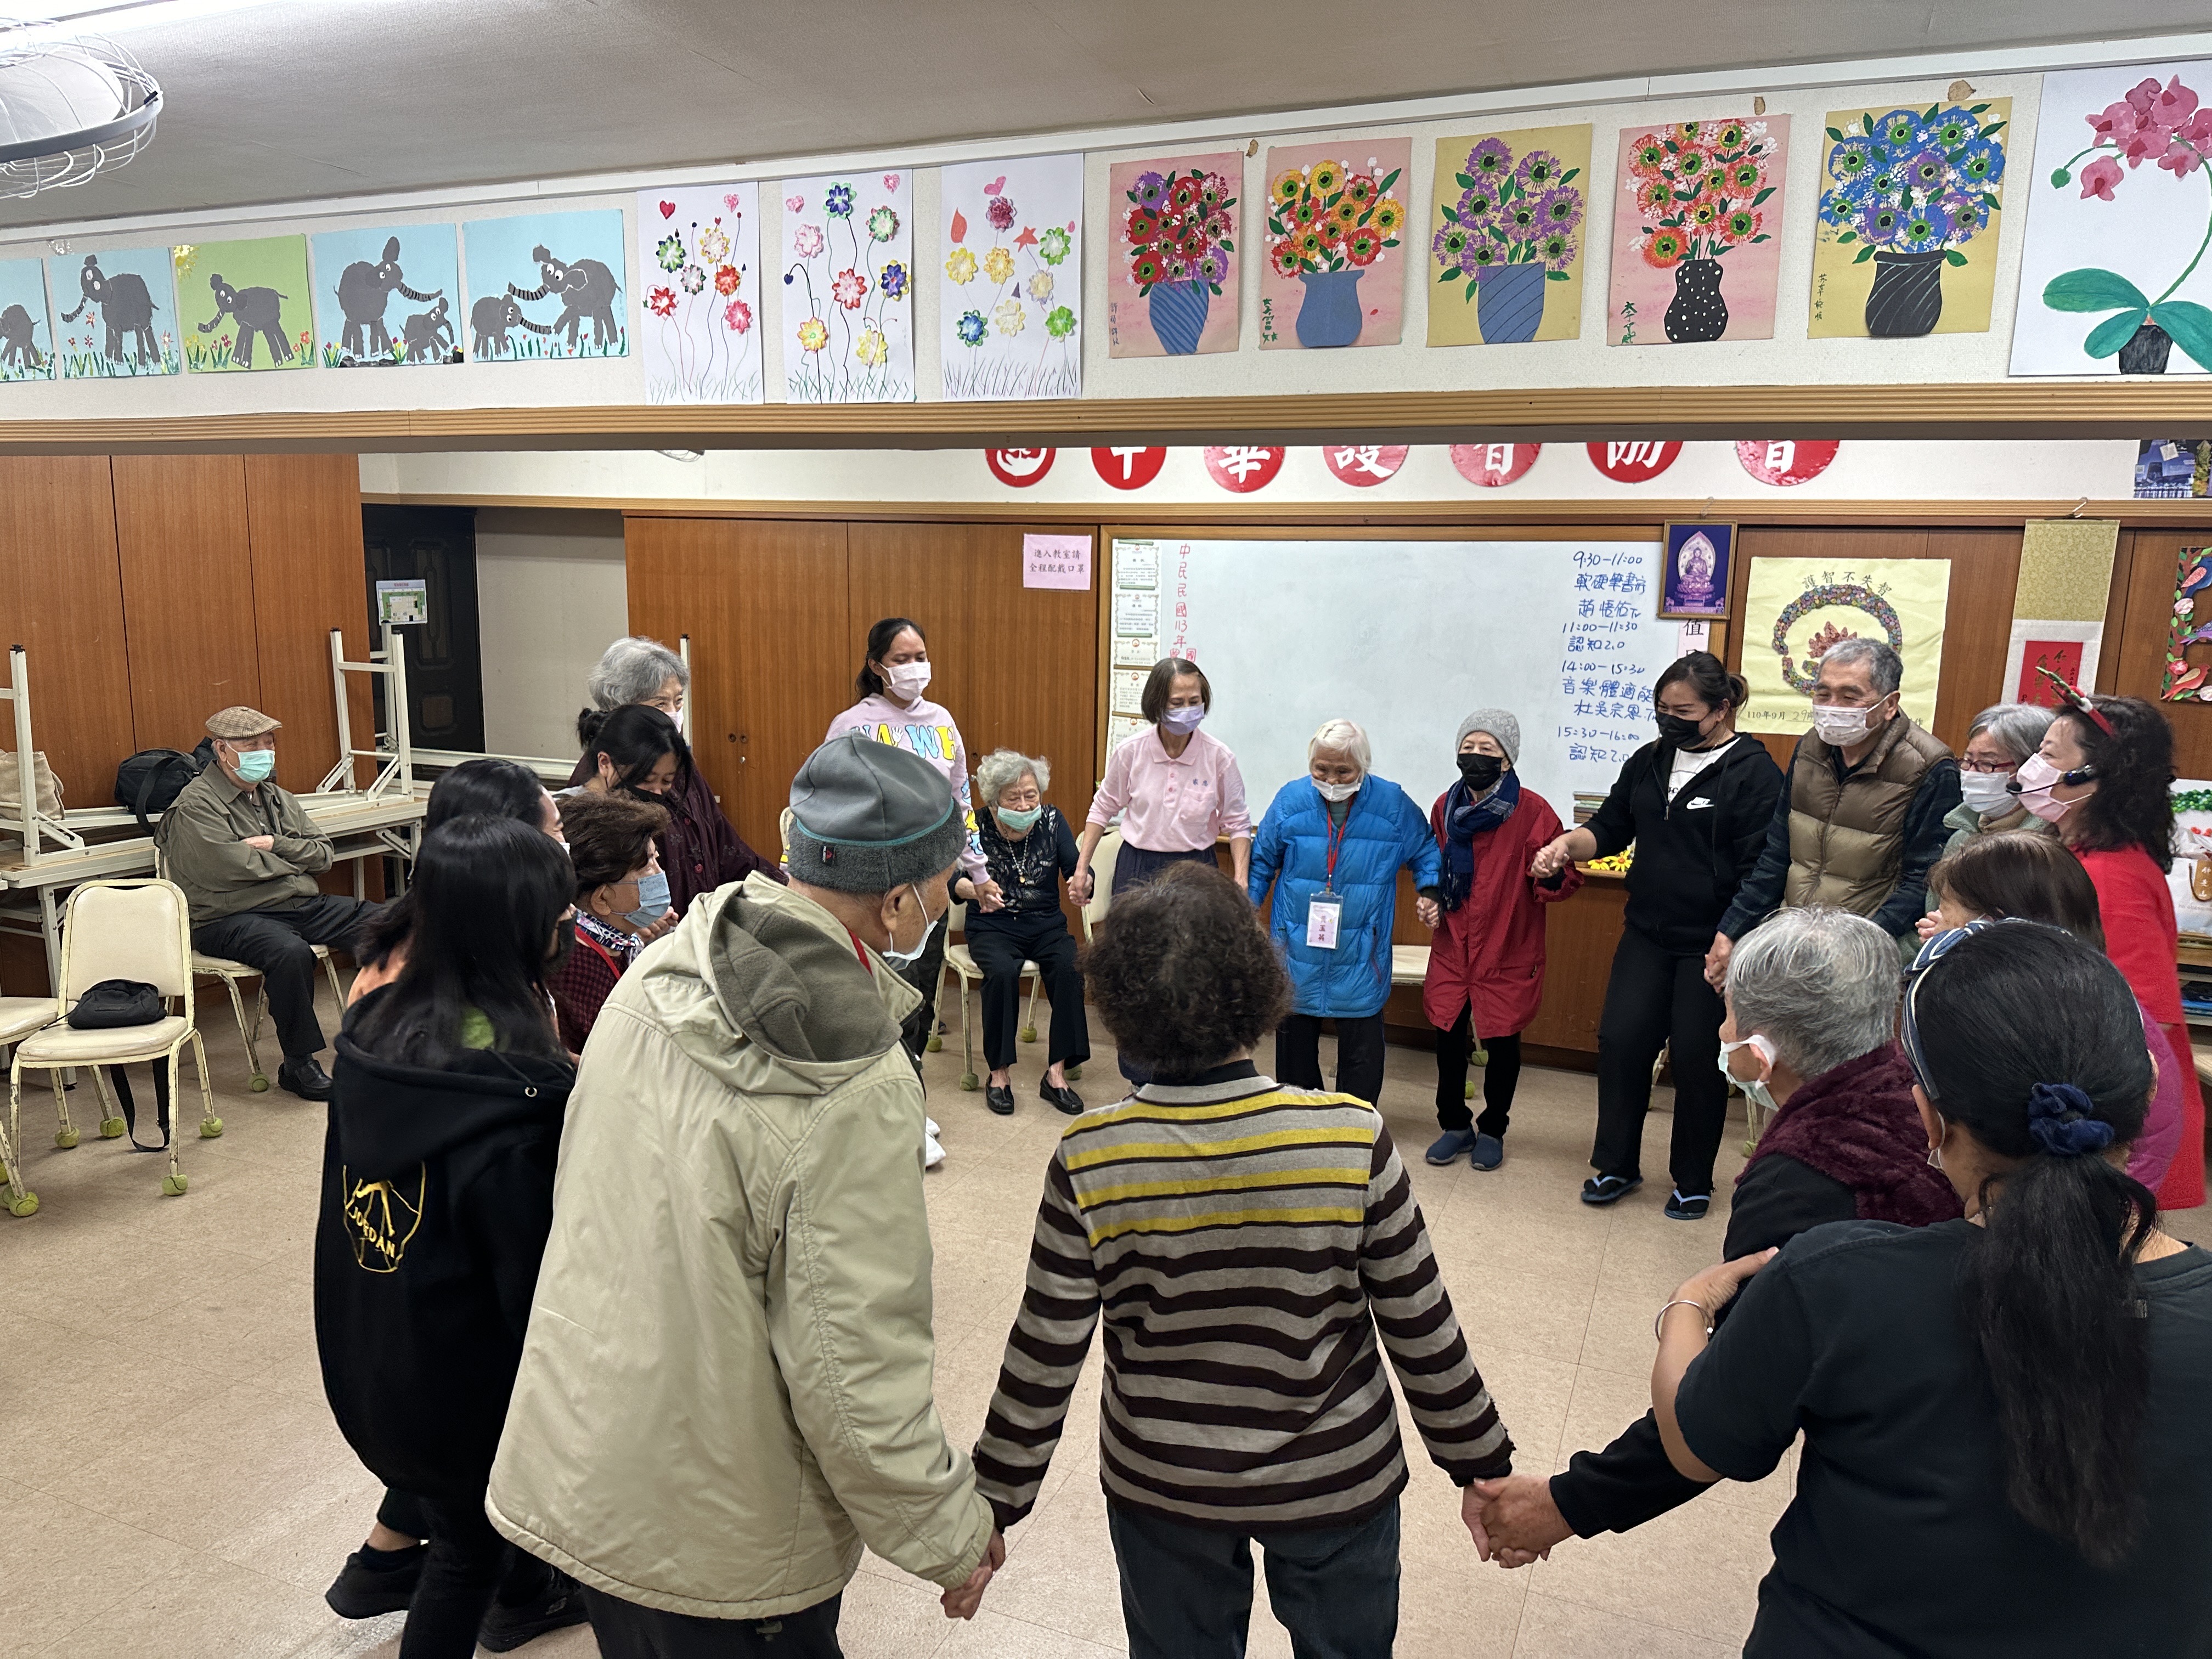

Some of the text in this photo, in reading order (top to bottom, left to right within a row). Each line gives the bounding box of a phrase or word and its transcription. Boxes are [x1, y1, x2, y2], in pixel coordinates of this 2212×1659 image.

[1034, 549, 1081, 560] 進入教室請
[1030, 563, 1085, 574] 全程配戴口罩
[348, 1207, 395, 1259] JORDAN
